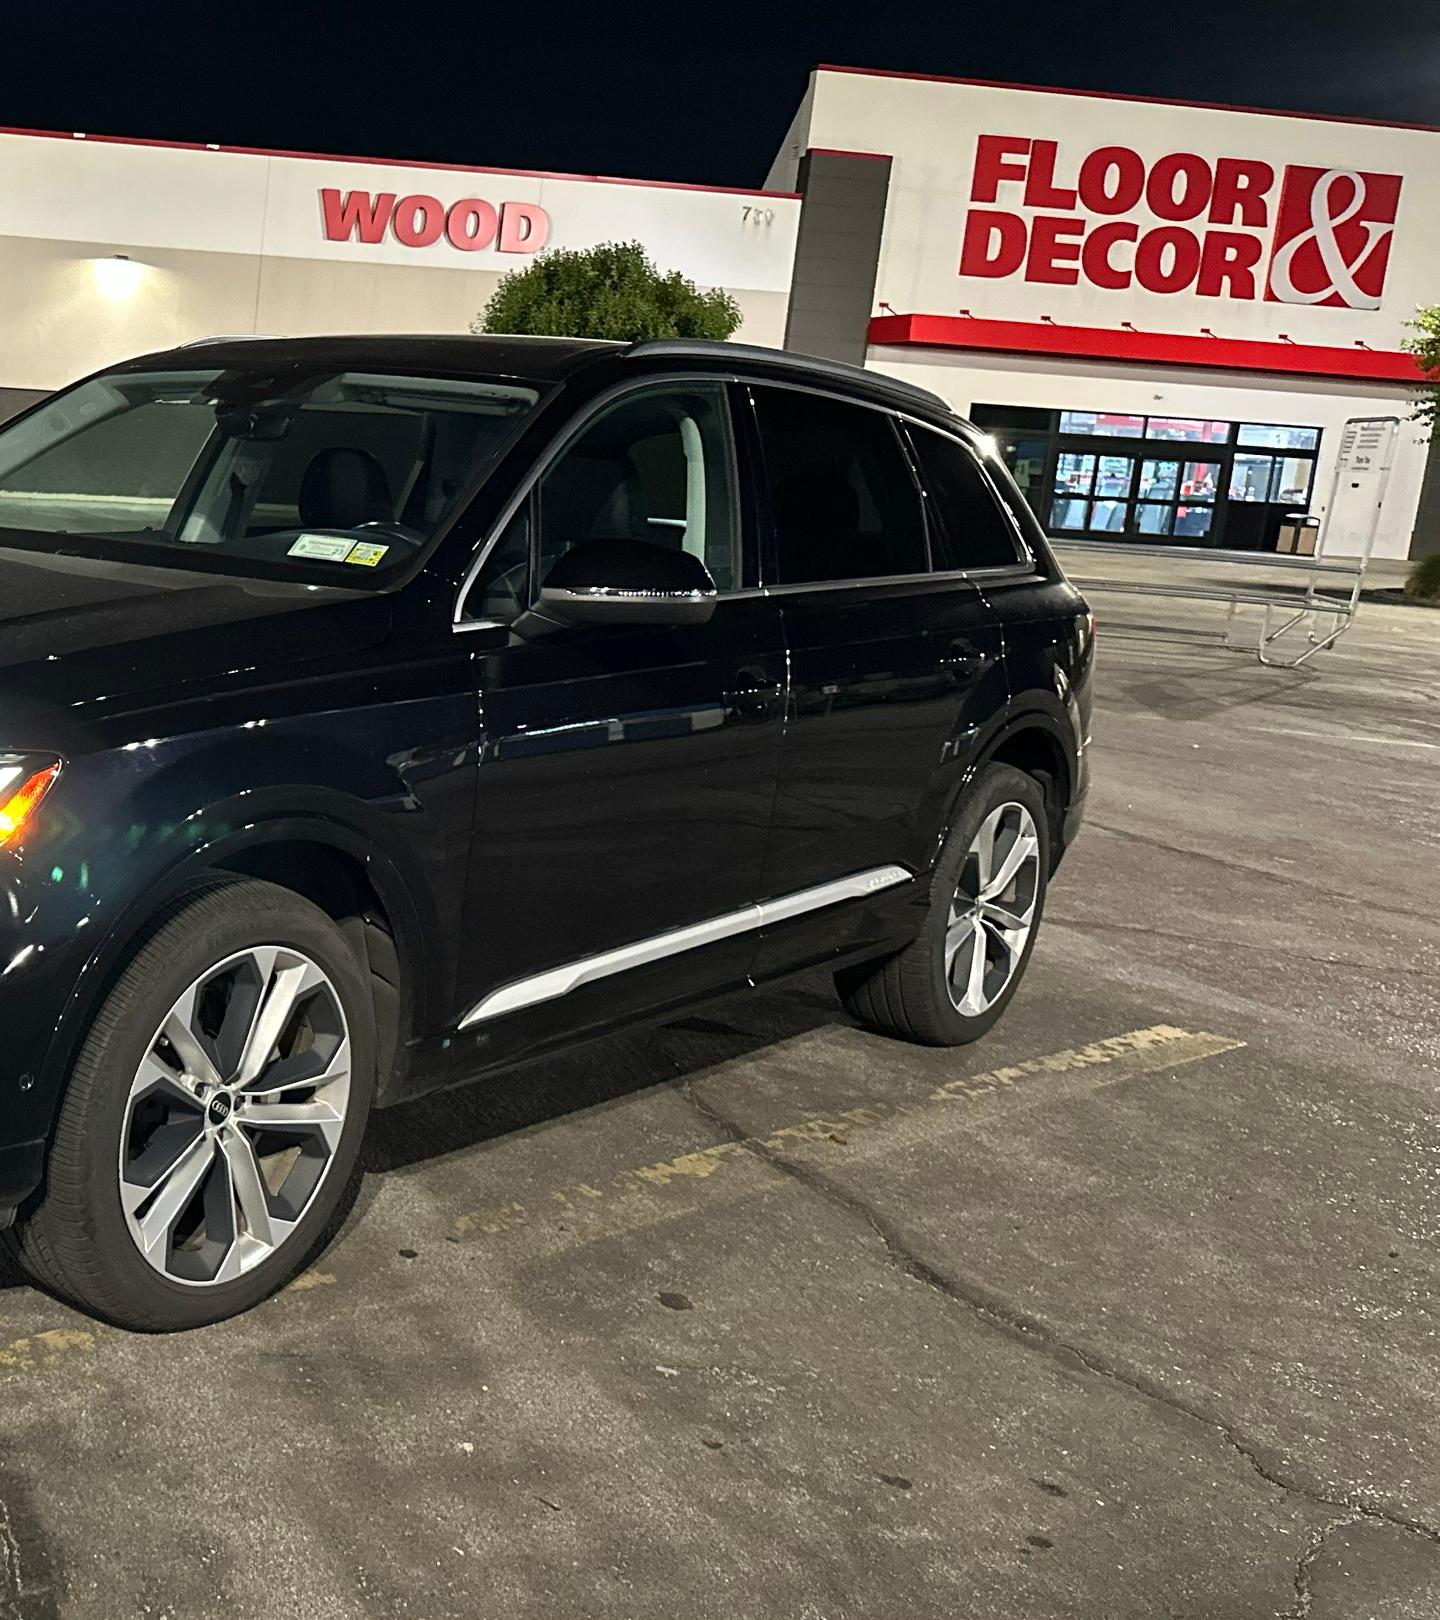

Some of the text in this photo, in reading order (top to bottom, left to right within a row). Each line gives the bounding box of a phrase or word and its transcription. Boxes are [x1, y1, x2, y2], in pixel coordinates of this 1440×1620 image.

[321, 188, 550, 253] WOOD
[970, 134, 1274, 228] FLOOR
[959, 209, 1263, 300] DECOR
